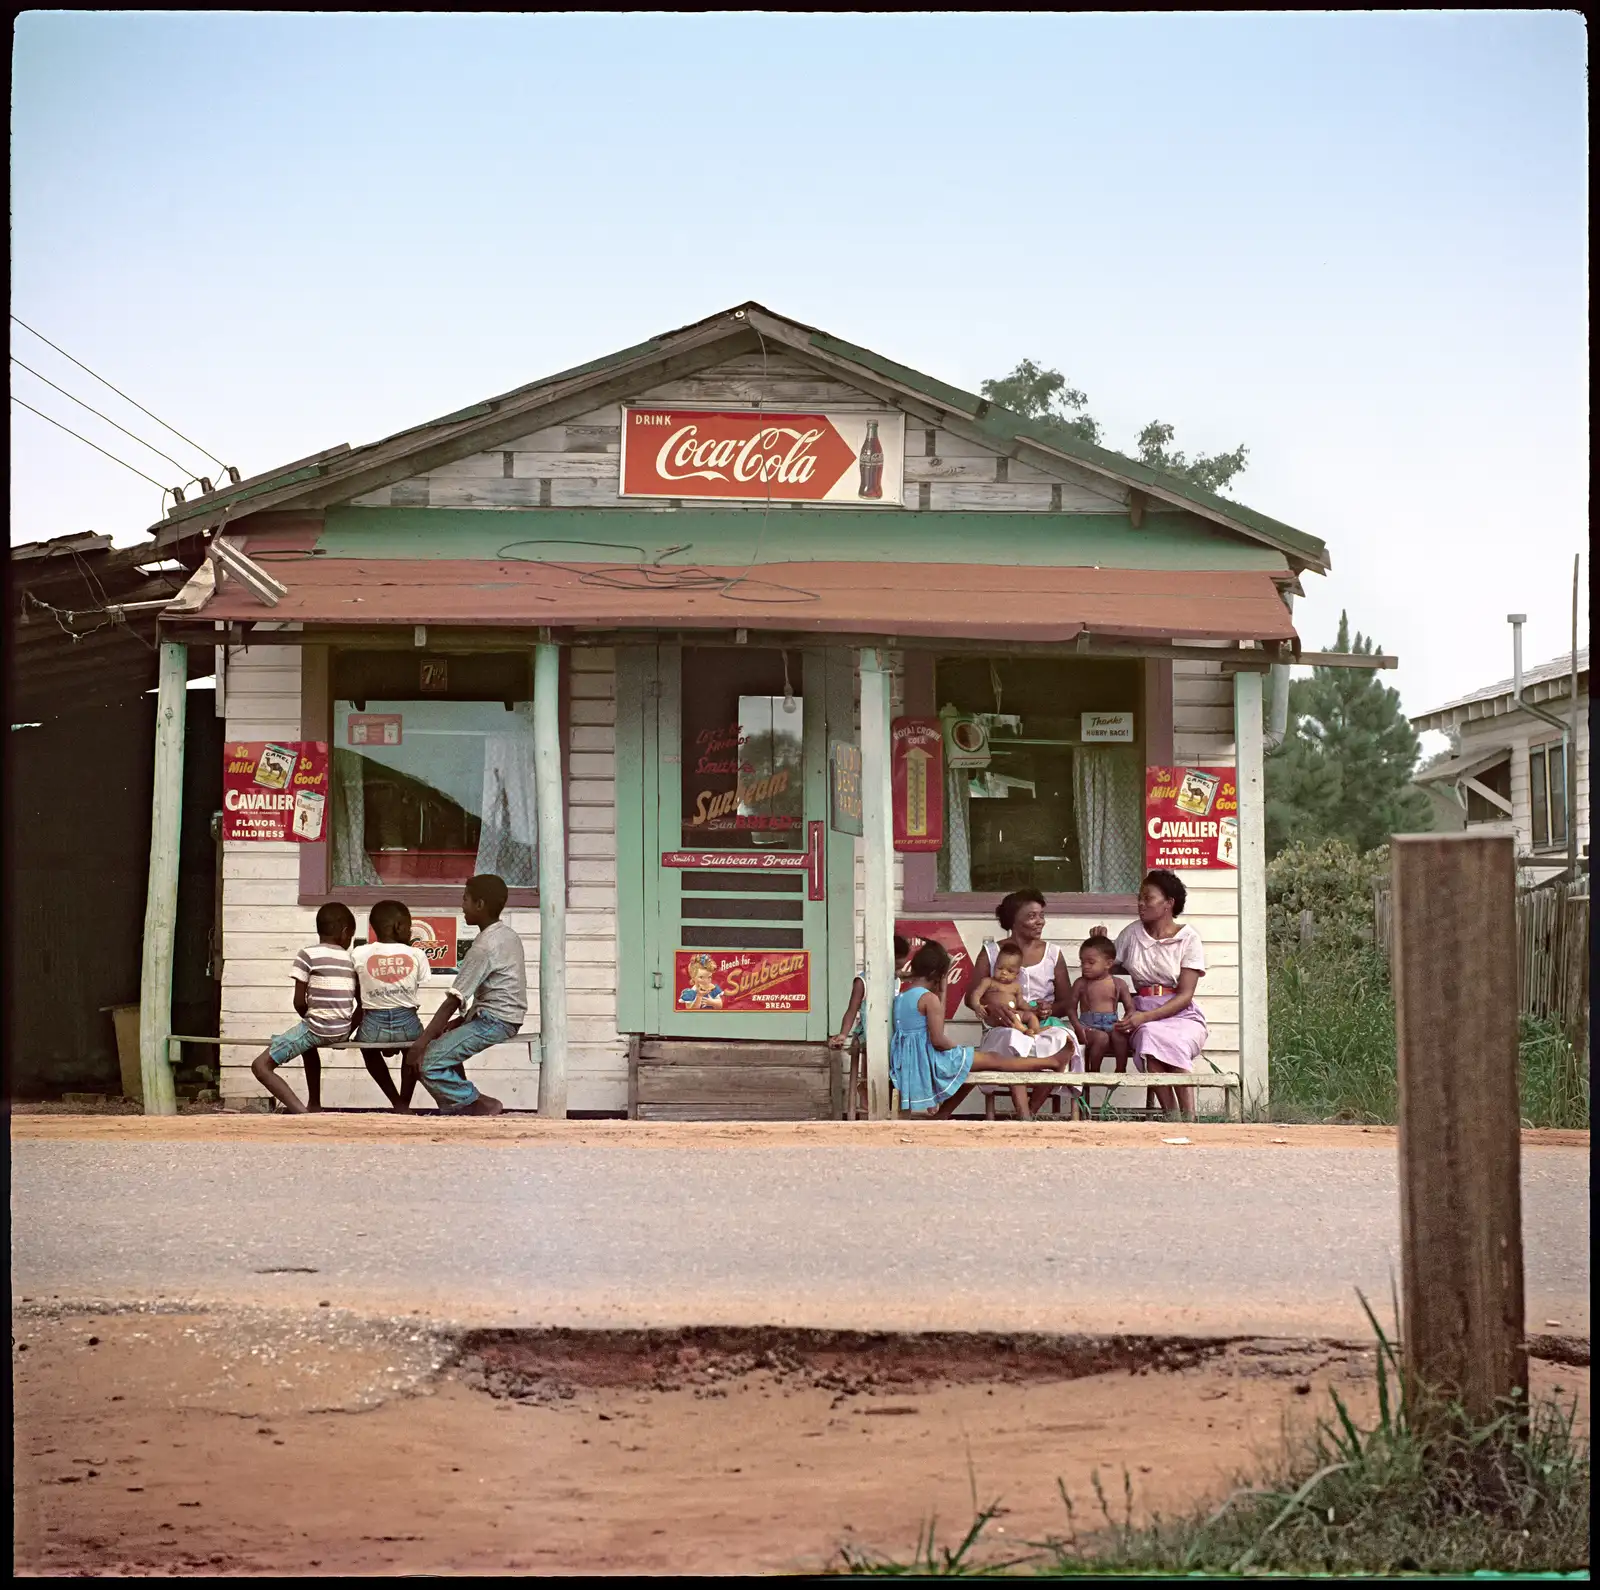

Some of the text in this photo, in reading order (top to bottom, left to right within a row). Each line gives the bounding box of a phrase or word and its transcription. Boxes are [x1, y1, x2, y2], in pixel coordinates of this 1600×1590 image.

[635, 414, 672, 426] DRINK
[655, 425, 827, 484] Coca-Cola
[1091, 716, 1123, 728] Thanks
[893, 726, 942, 742] ROYAL CROWN
[235, 746, 249, 758] So
[265, 752, 290, 764] CAMEL
[228, 761, 255, 773] Mild
[299, 757, 313, 770] So
[294, 772, 324, 785] Good
[1156, 770, 1171, 783] So
[1186, 777, 1211, 789] CAMEL
[1150, 786, 1178, 799] Mild
[1221, 783, 1236, 796] So
[225, 789, 294, 811] CAVALIER
[693, 769, 788, 825] Sunbeam
[1216, 798, 1237, 810] Goo
[736, 814, 793, 829] BREAD
[1148, 816, 1219, 839] CAVALIER
[231, 830, 285, 838] MILDNESS
[700, 855, 758, 866] Sunbeam
[763, 855, 805, 866] Bread
[1155, 858, 1209, 866] MILDNESS
[377, 957, 404, 966] RED
[371, 966, 412, 977] HEART
[724, 954, 805, 996] Sunbeam
